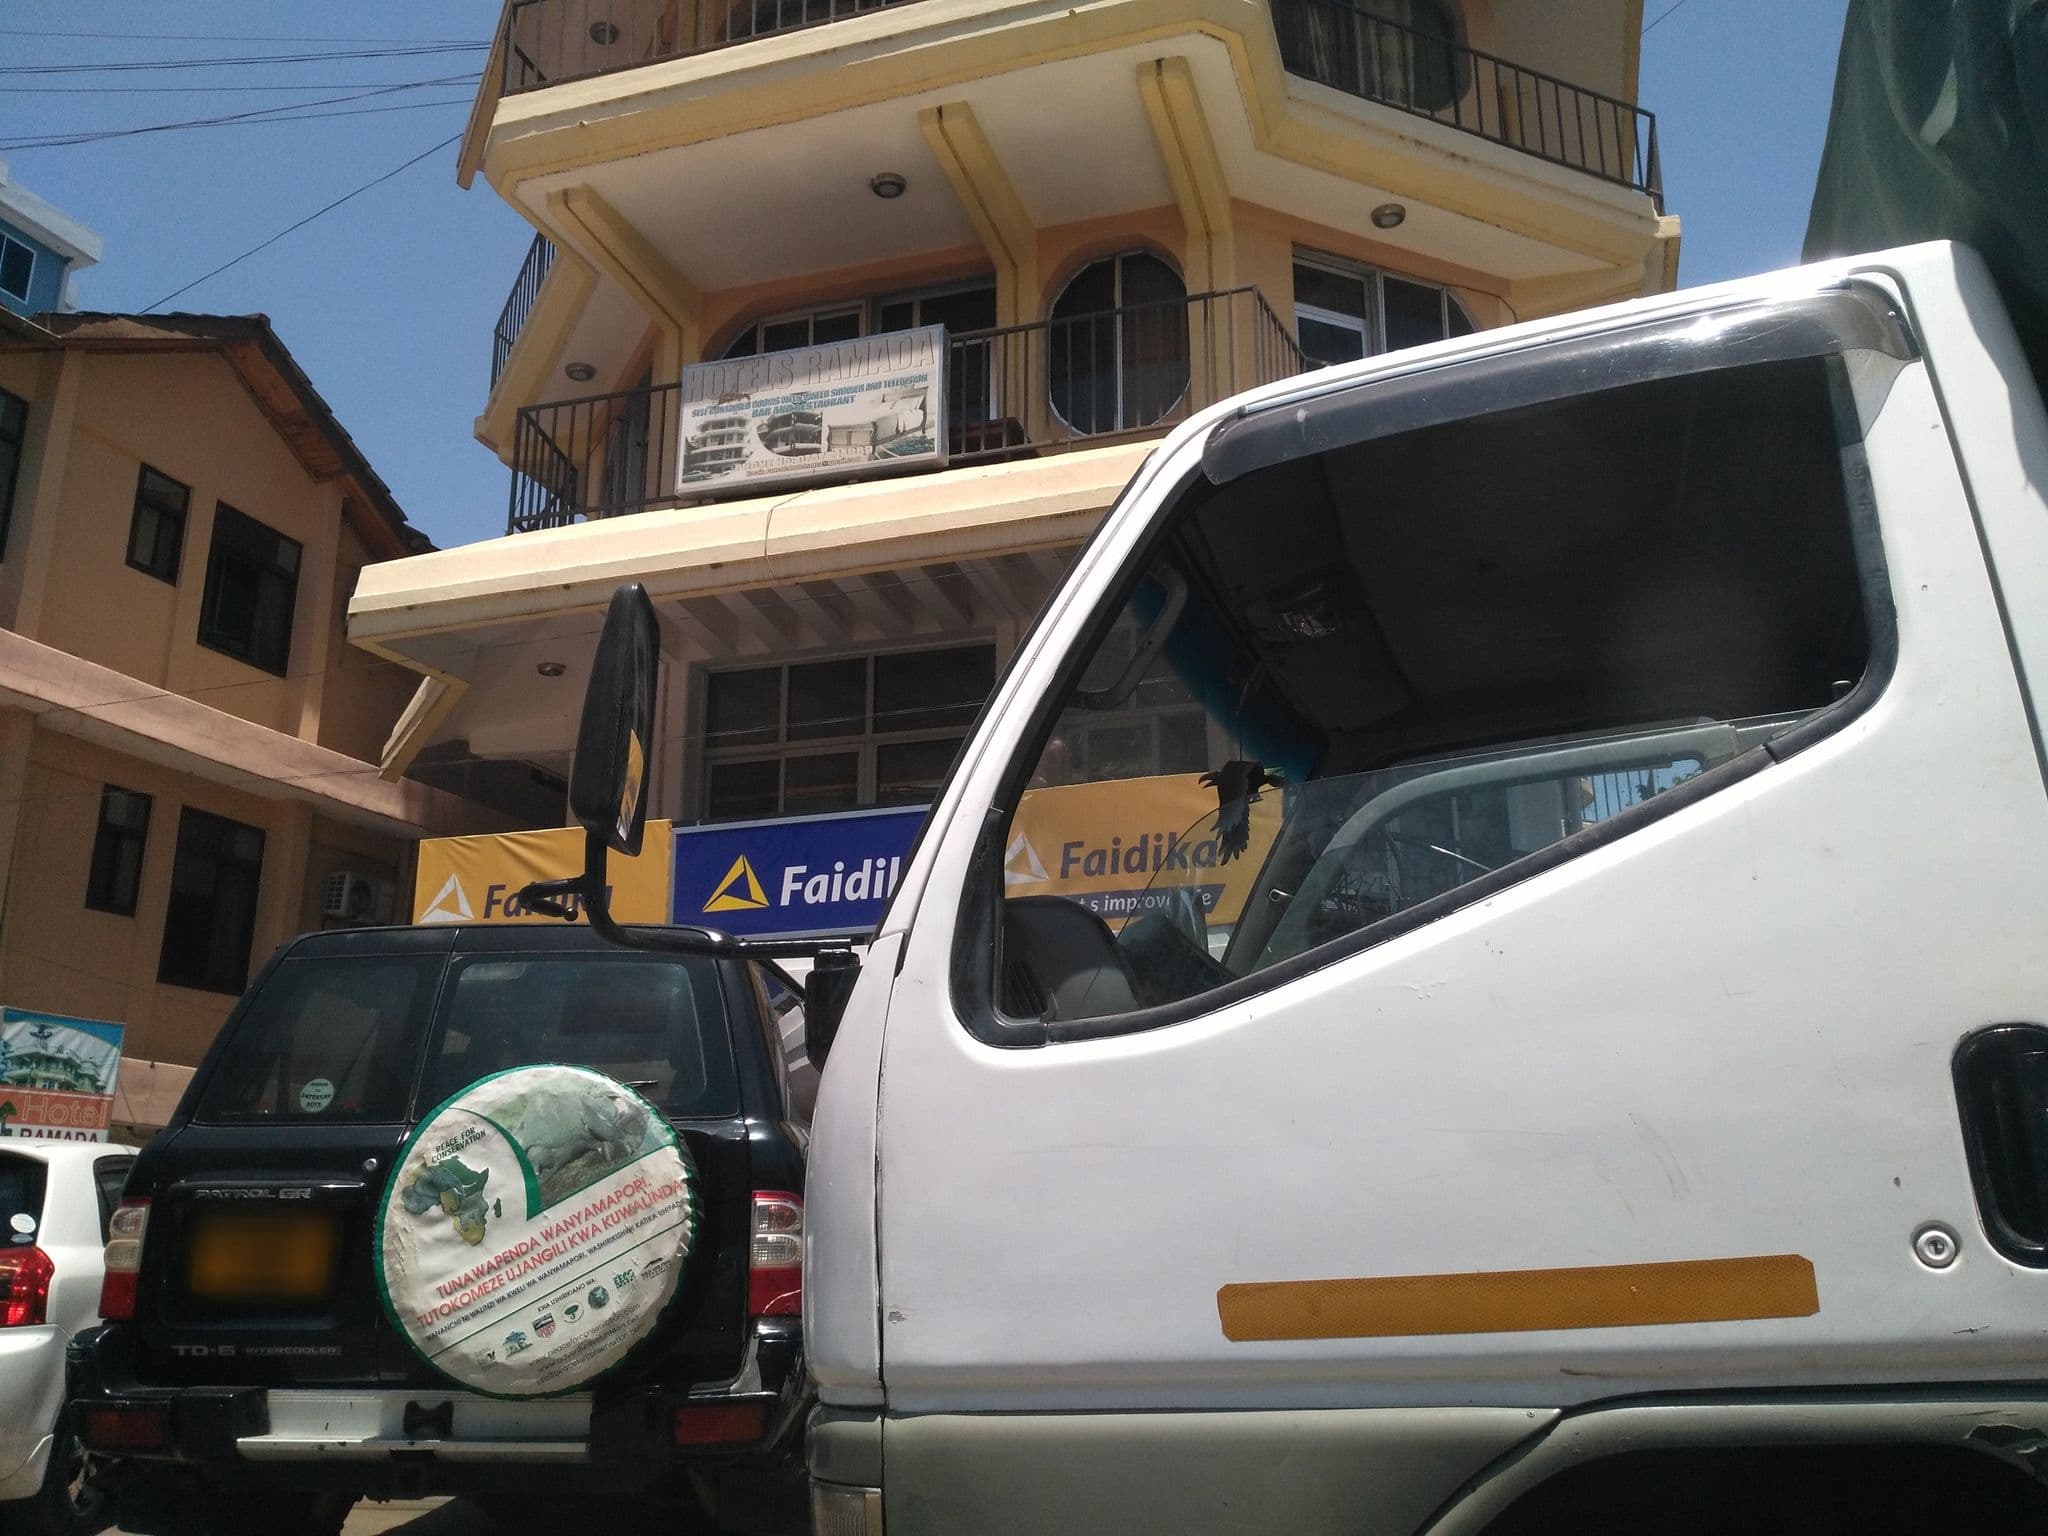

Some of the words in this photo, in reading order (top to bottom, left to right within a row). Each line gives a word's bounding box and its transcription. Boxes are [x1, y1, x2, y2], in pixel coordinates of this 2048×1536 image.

[685, 353, 794, 403] HOTELS
[803, 331, 934, 385] RAMADA
[793, 395, 856, 412] RESTAURANT
[1059, 832, 1218, 880] Faidika
[22, 1094, 108, 1128] Hotel
[20, 1128, 98, 1142] RAMADA
[432, 1128, 486, 1163] CONSERVATION
[436, 1136, 457, 1152] PEACE
[461, 1127, 475, 1139] FOR
[196, 1188, 276, 1199] PATROL
[278, 1188, 311, 1199] GR
[417, 1274, 506, 1329] TUTOKOMEZE
[505, 1240, 568, 1281] UJANGILI
[568, 1223, 601, 1249] KWA
[601, 1180, 683, 1230] KUWALINDA
[436, 1237, 541, 1298] TUNAWAPENDA
[495, 1295, 507, 1304] WA
[526, 1278, 537, 1288] WA
